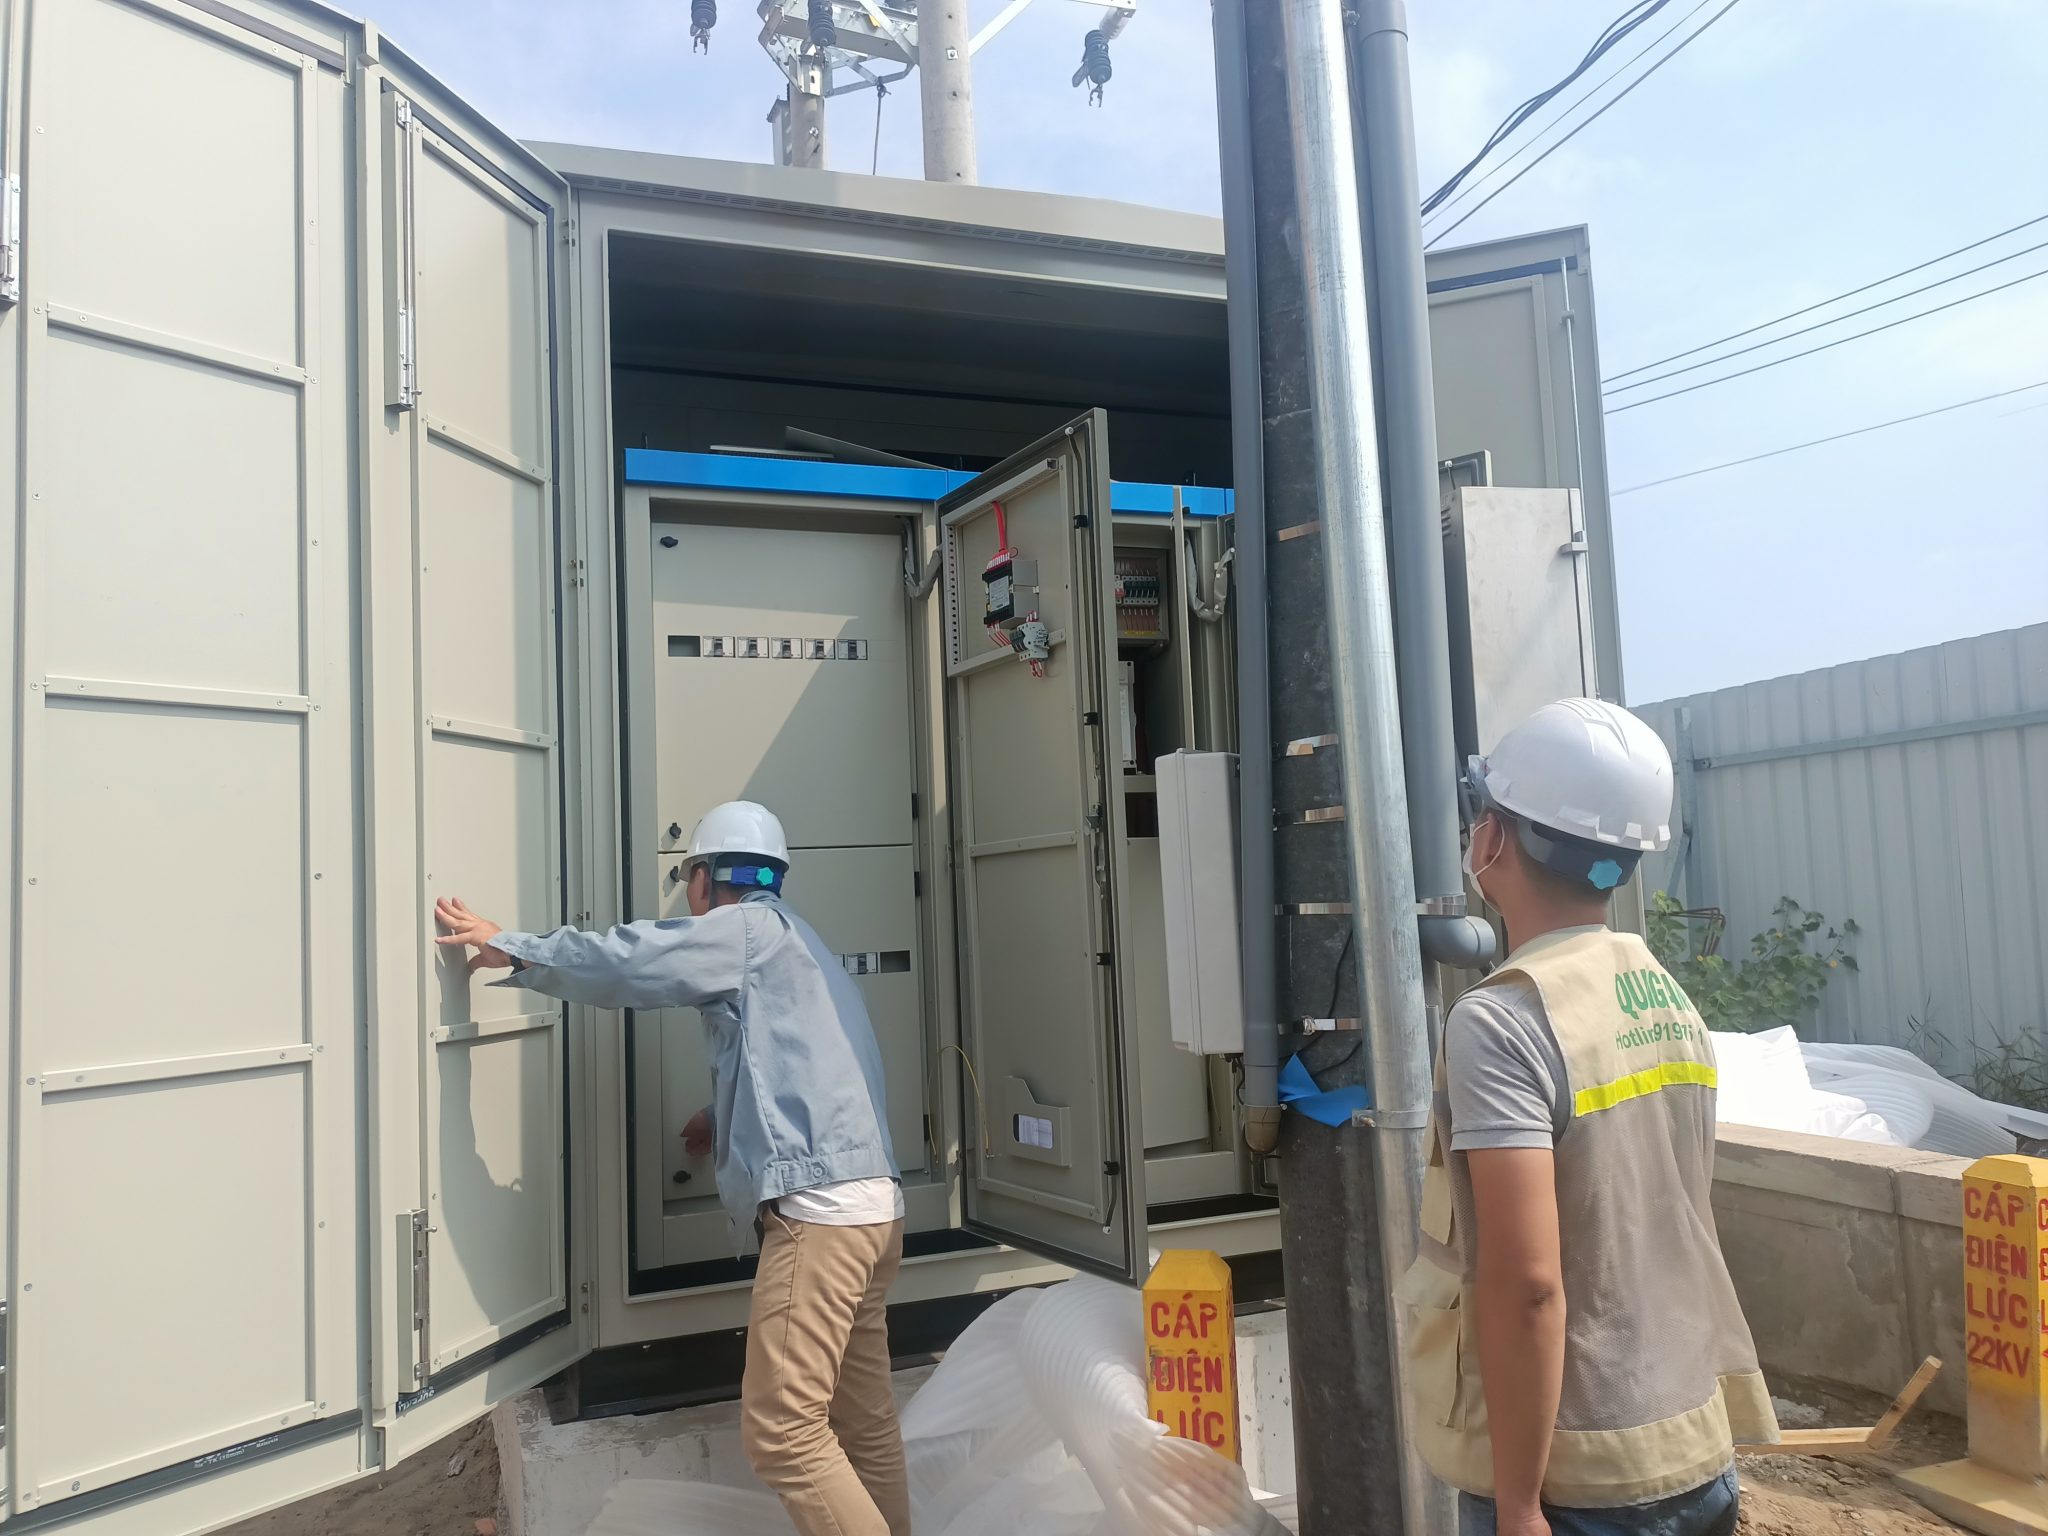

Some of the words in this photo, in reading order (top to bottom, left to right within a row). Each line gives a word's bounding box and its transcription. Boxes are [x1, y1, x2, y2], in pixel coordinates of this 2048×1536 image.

[1965, 1183, 2024, 1227] CÁP
[1965, 1233, 2027, 1285] ĐIỆN
[1150, 1292, 1218, 1339] CÁP
[1967, 1283, 2028, 1333] LỰC
[1154, 1348, 1223, 1404] ĐIỆN
[1968, 1331, 2030, 1378] 22KV
